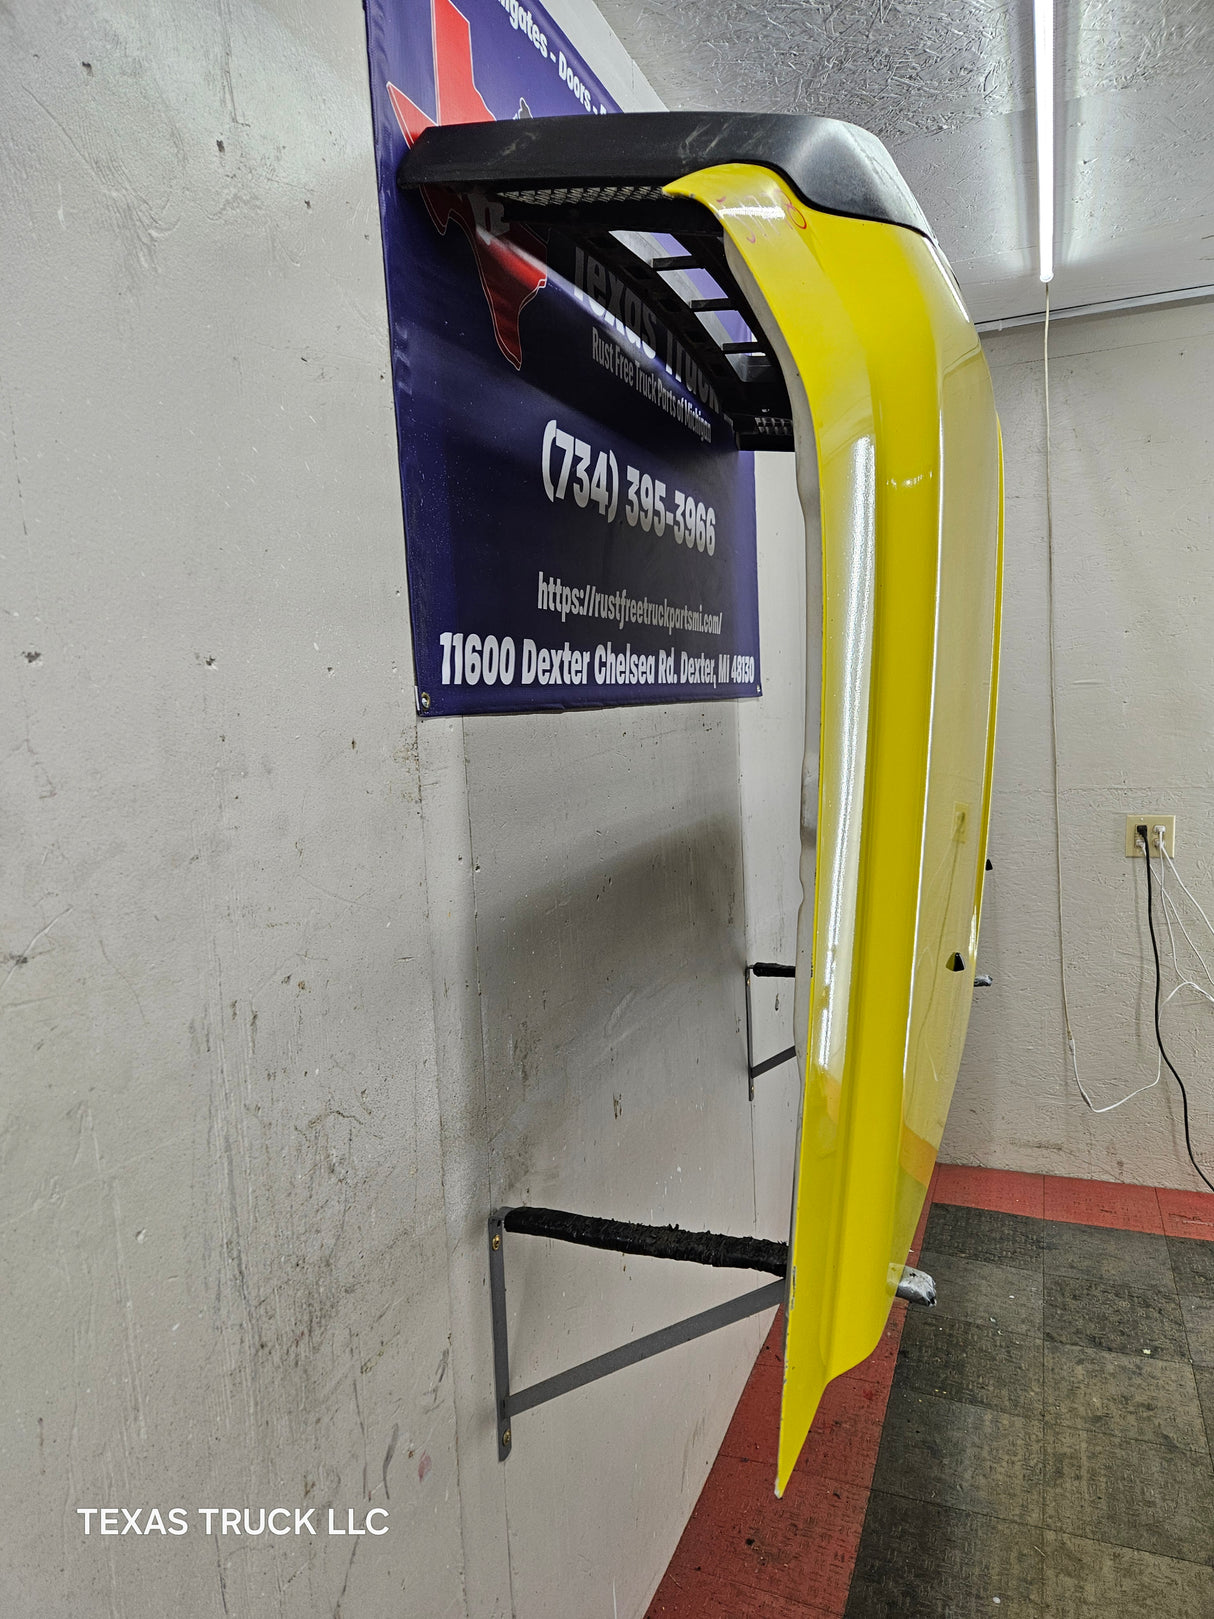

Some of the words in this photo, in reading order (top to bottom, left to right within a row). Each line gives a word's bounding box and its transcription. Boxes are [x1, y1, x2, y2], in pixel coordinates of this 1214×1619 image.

[498, 0, 548, 58] gates
[558, 51, 591, 113] Doors
[592, 327, 614, 373] Rust
[615, 345, 634, 387] Free
[635, 360, 657, 404] Truck
[657, 378, 676, 418] Parts
[676, 397, 685, 423] of
[684, 399, 712, 444] Michigan
[542, 419, 619, 523] (734)
[625, 465, 716, 556] 395-3966
[538, 571, 722, 635] https://rustfreetruckpartsmi.com/
[440, 632, 515, 685] 11600
[521, 638, 590, 685] Dexter
[594, 641, 655, 685] Chelsea
[658, 647, 677, 684] Rd.
[680, 651, 717, 689] Dexter,
[731, 655, 755, 684] 48130
